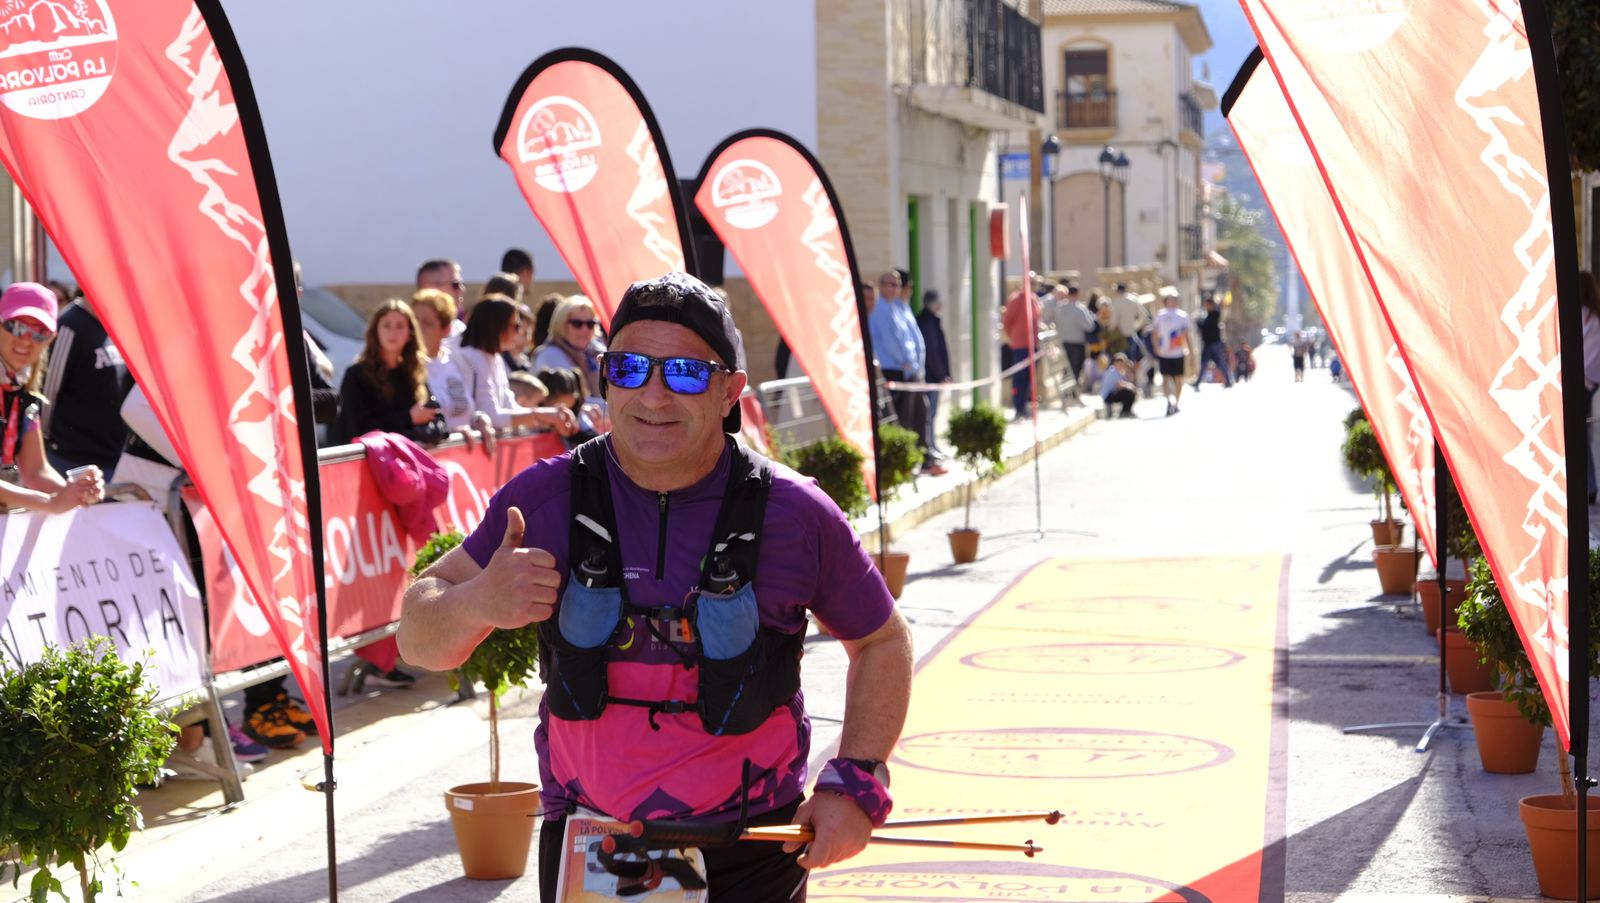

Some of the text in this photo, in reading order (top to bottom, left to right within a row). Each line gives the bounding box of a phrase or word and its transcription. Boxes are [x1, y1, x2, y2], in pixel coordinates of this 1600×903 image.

[128, 549, 165, 578] DE
[817, 879, 1153, 894] LA POLVORA
